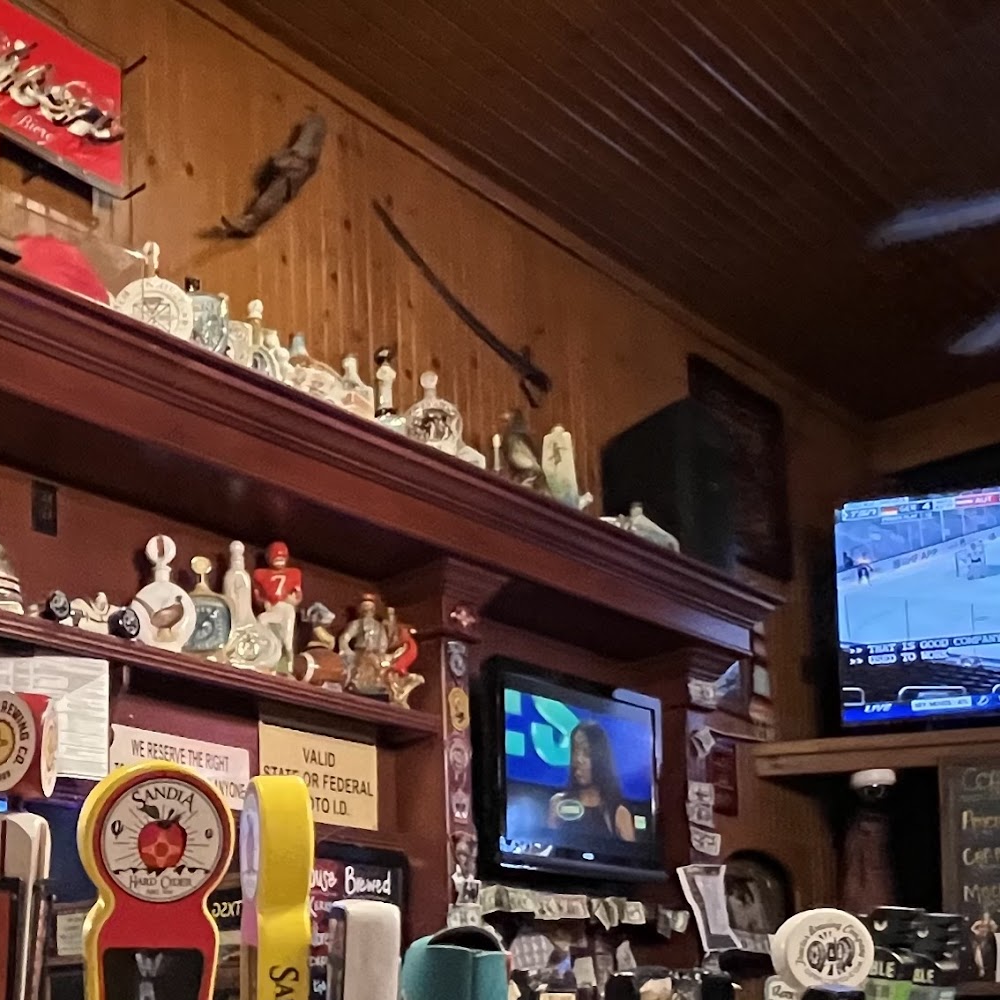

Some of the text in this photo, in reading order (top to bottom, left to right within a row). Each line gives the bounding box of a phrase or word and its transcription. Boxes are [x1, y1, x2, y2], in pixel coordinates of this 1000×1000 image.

[270, 574, 287, 598] 7
[919, 638, 949, 649] GOOD
[131, 739, 230, 773] WE RESERVE THE RIGHT
[302, 747, 336, 768] VALID
[303, 771, 320, 789] OR
[322, 774, 374, 797] FEDERAL
[132, 786, 195, 813] SANDIA
[130, 875, 157, 889] HARD
[344, 865, 392, 896] Brewed
